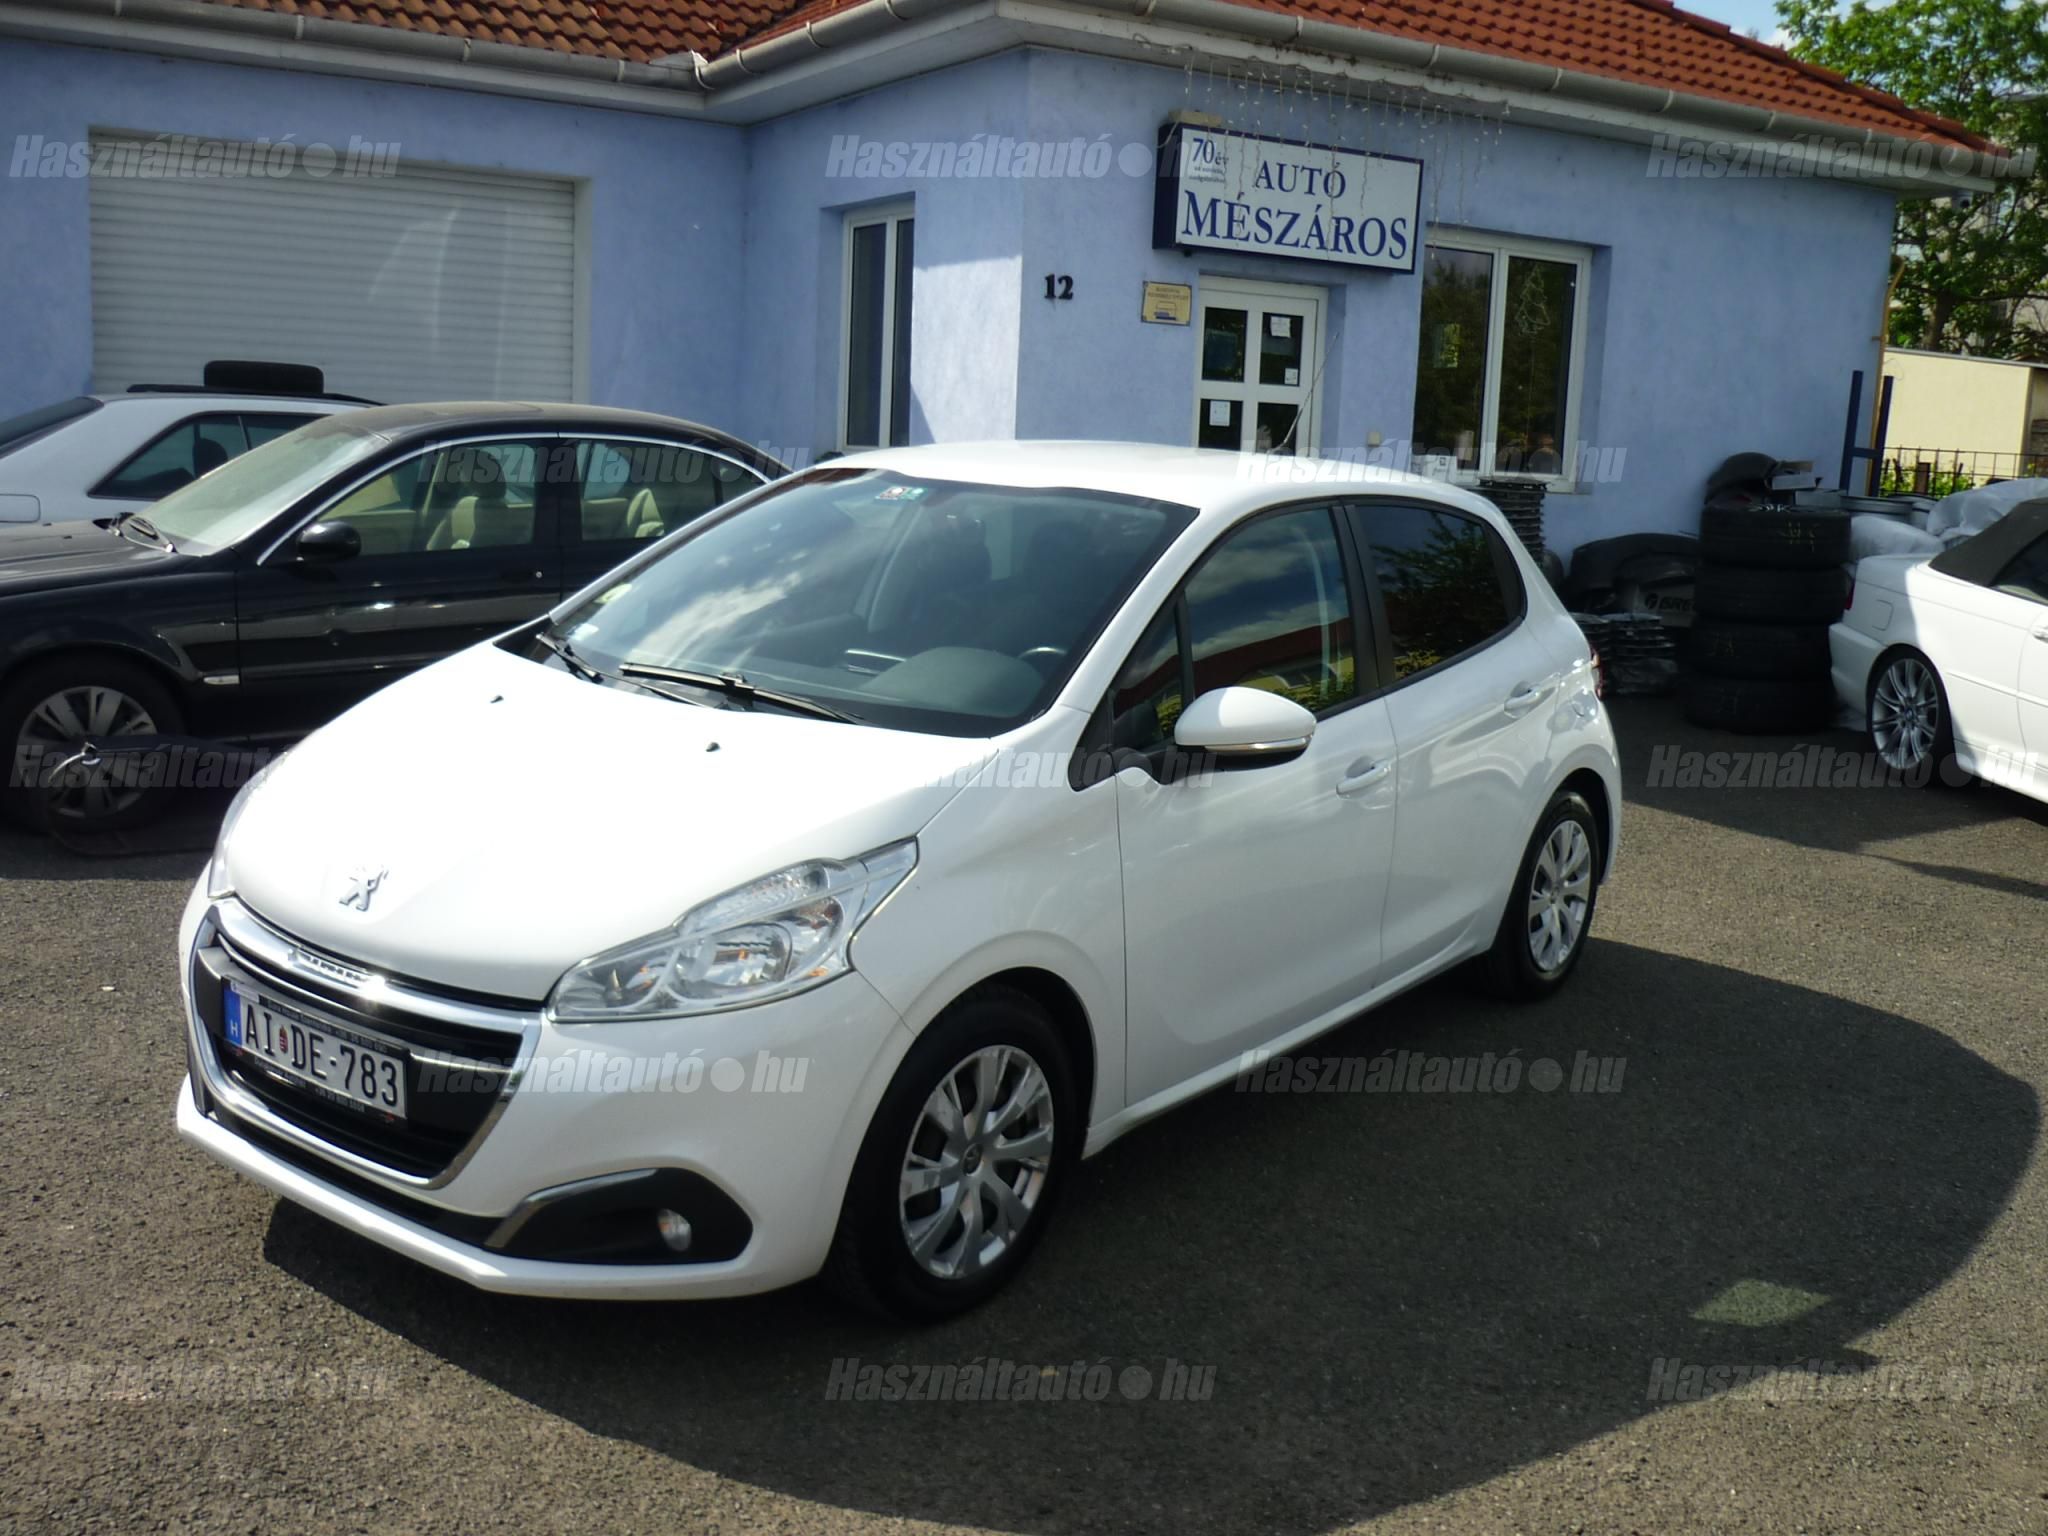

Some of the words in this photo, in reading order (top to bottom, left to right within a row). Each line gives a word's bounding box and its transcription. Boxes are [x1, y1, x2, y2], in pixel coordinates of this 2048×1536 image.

[1255, 160, 1346, 198] AUTÓ
[1182, 190, 1407, 260] MÉSZÁROS
[1044, 273, 1074, 300] 12
